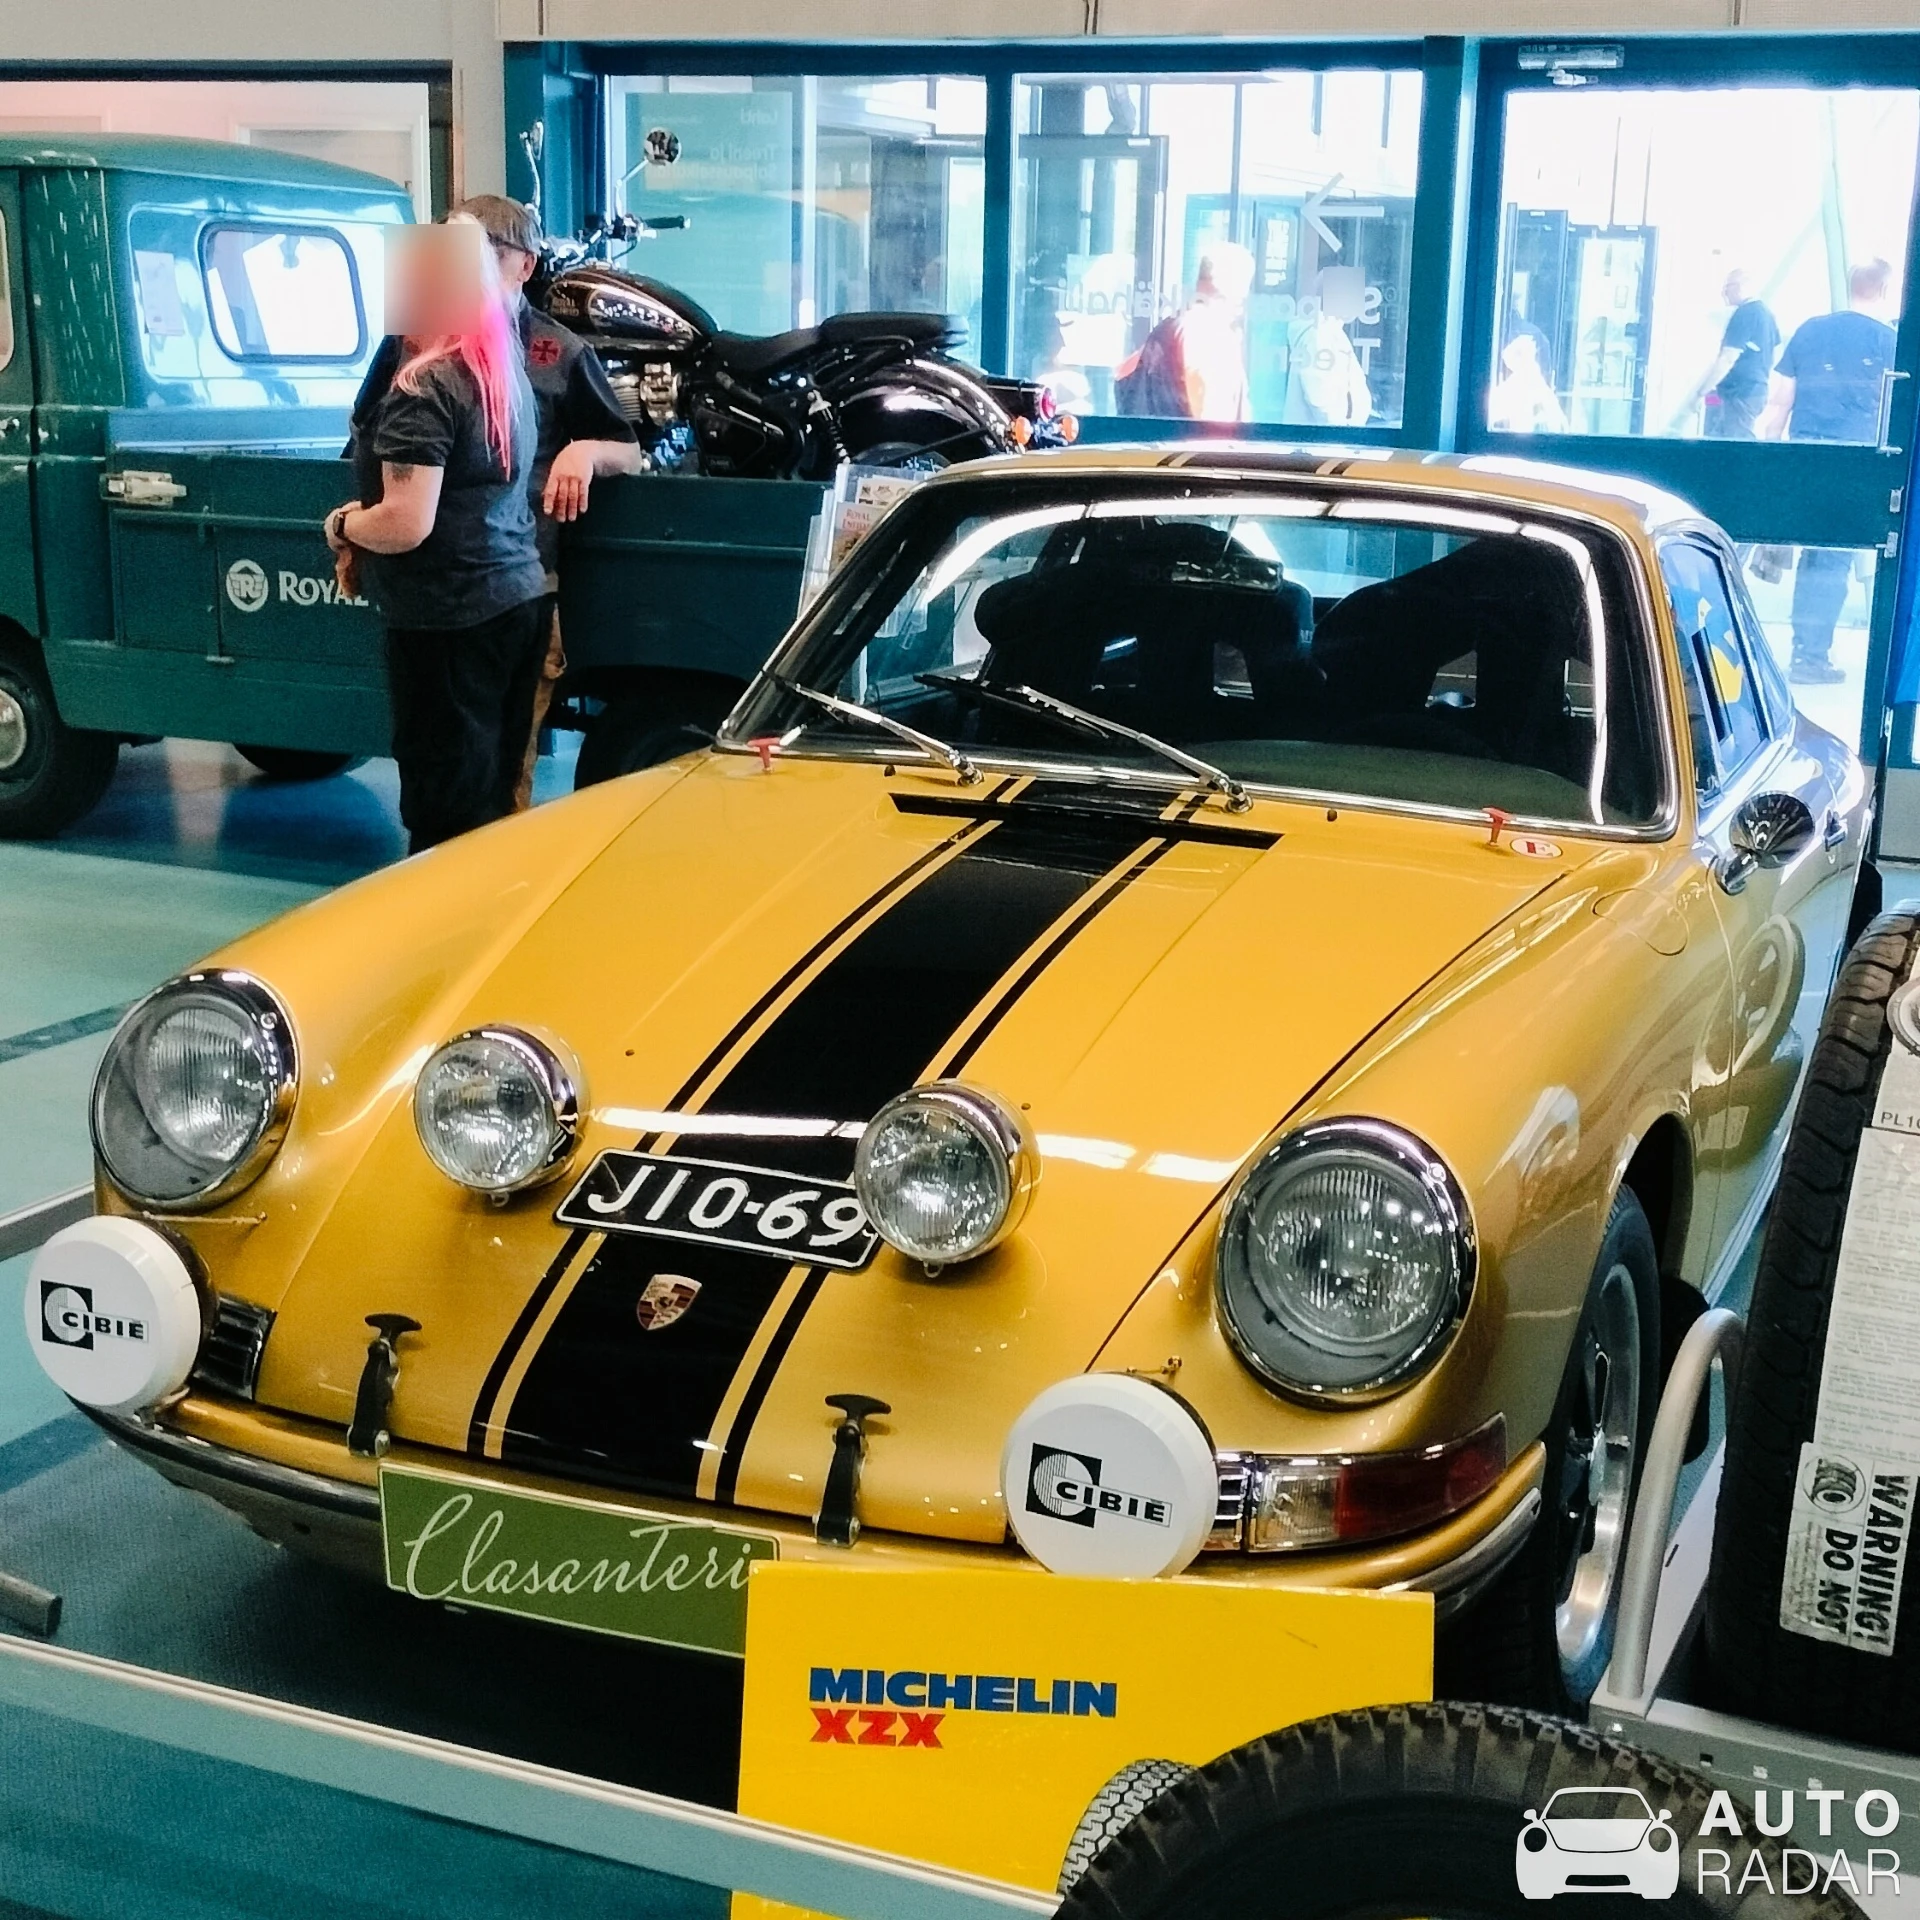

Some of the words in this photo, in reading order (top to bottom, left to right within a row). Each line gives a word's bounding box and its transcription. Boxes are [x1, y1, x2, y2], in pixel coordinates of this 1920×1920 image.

[1822, 1526, 1858, 1572] DO
[1852, 1474, 1911, 1646] WARNING!
[1814, 1578, 1852, 1635] NOT
[809, 1666, 1117, 1718] MICHELIN
[809, 1707, 945, 1749] XZX
